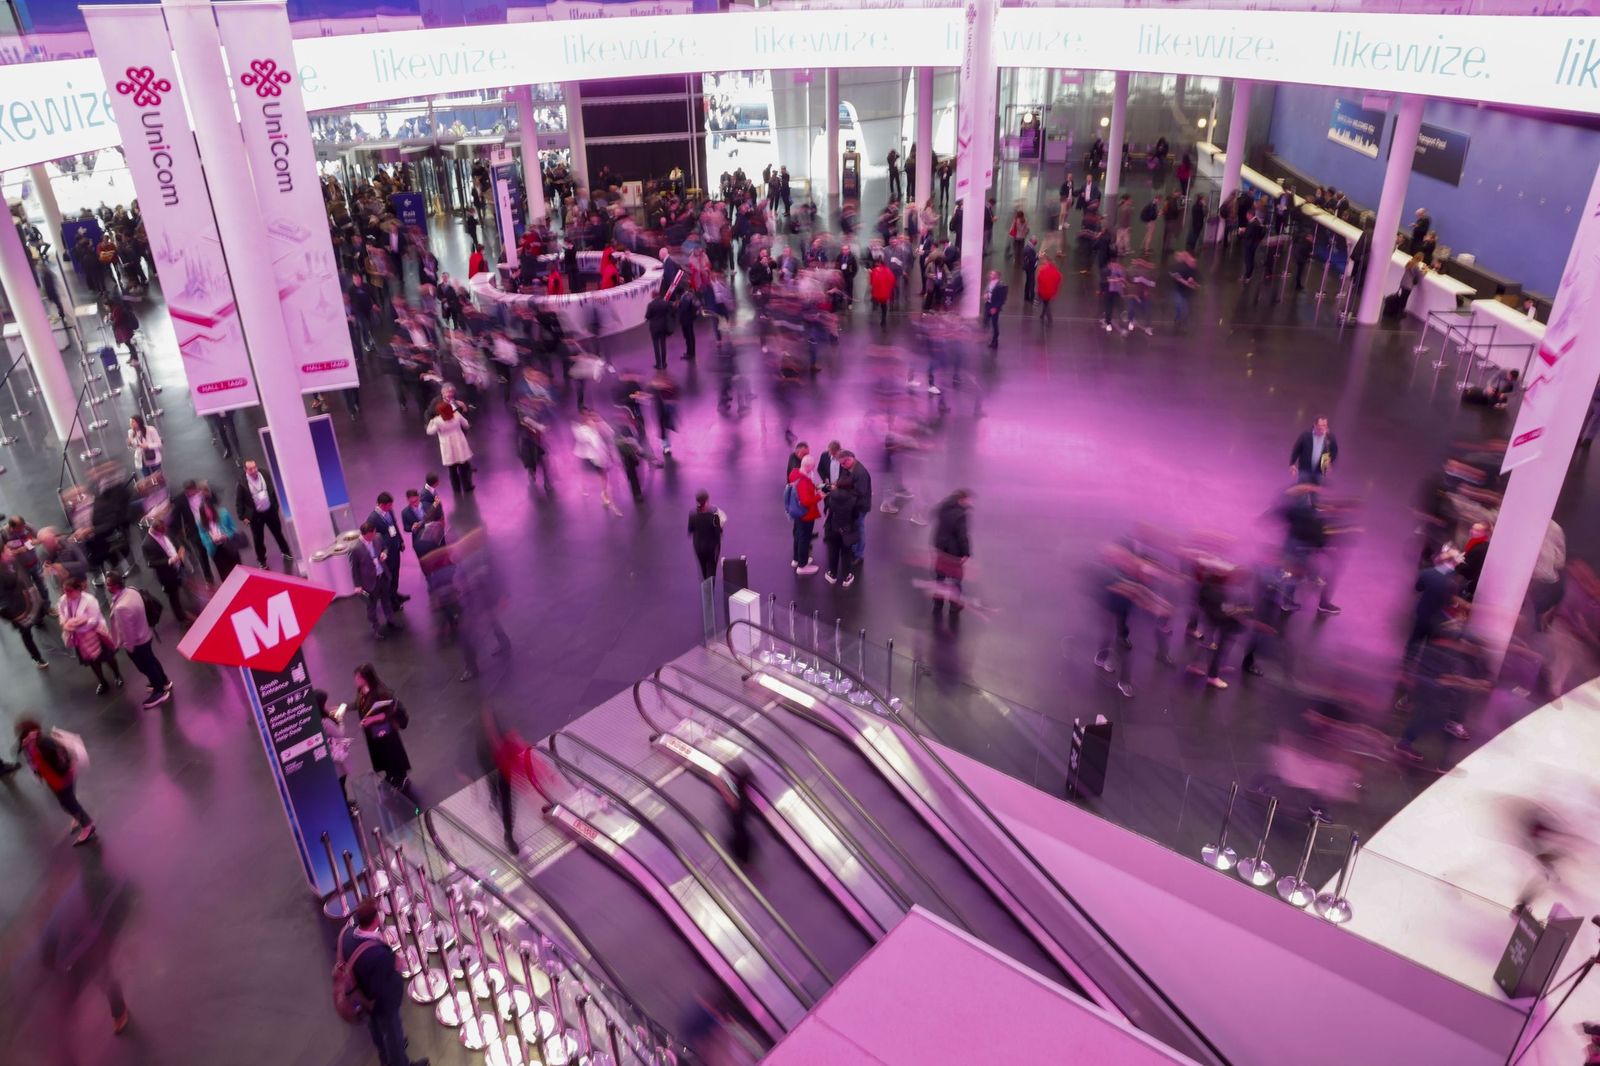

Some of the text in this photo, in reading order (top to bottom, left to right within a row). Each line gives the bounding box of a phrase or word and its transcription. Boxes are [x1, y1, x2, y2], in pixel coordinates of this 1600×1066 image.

[562, 31, 704, 65] likewize.
[753, 26, 896, 54] likewize.
[946, 23, 1088, 53] liwize.
[1137, 24, 1280, 63] likewize.
[1332, 30, 1491, 80] likewize.
[372, 44, 516, 84] likewize.
[141, 111, 179, 207] UniCom
[262, 102, 293, 194] UniCom
[230, 589, 301, 661] M
[260, 679, 279, 691] South
[261, 681, 289, 698] Entrance
